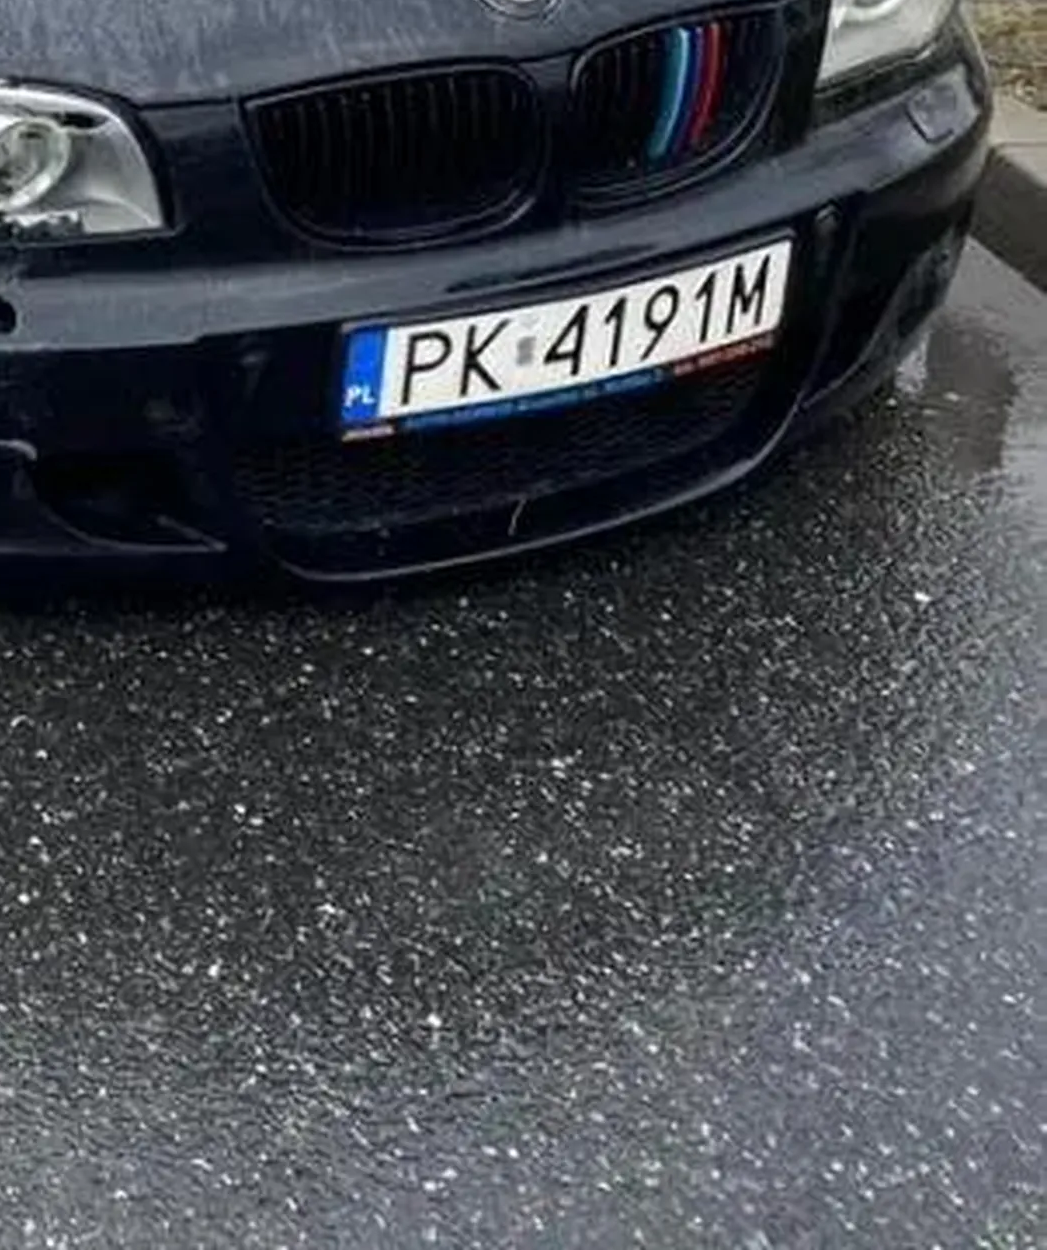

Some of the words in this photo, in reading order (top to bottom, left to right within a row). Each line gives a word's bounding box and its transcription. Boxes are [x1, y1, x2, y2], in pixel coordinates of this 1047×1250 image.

[399, 318, 510, 406] PK
[544, 254, 772, 376] 4191M
[344, 384, 376, 407] PL
